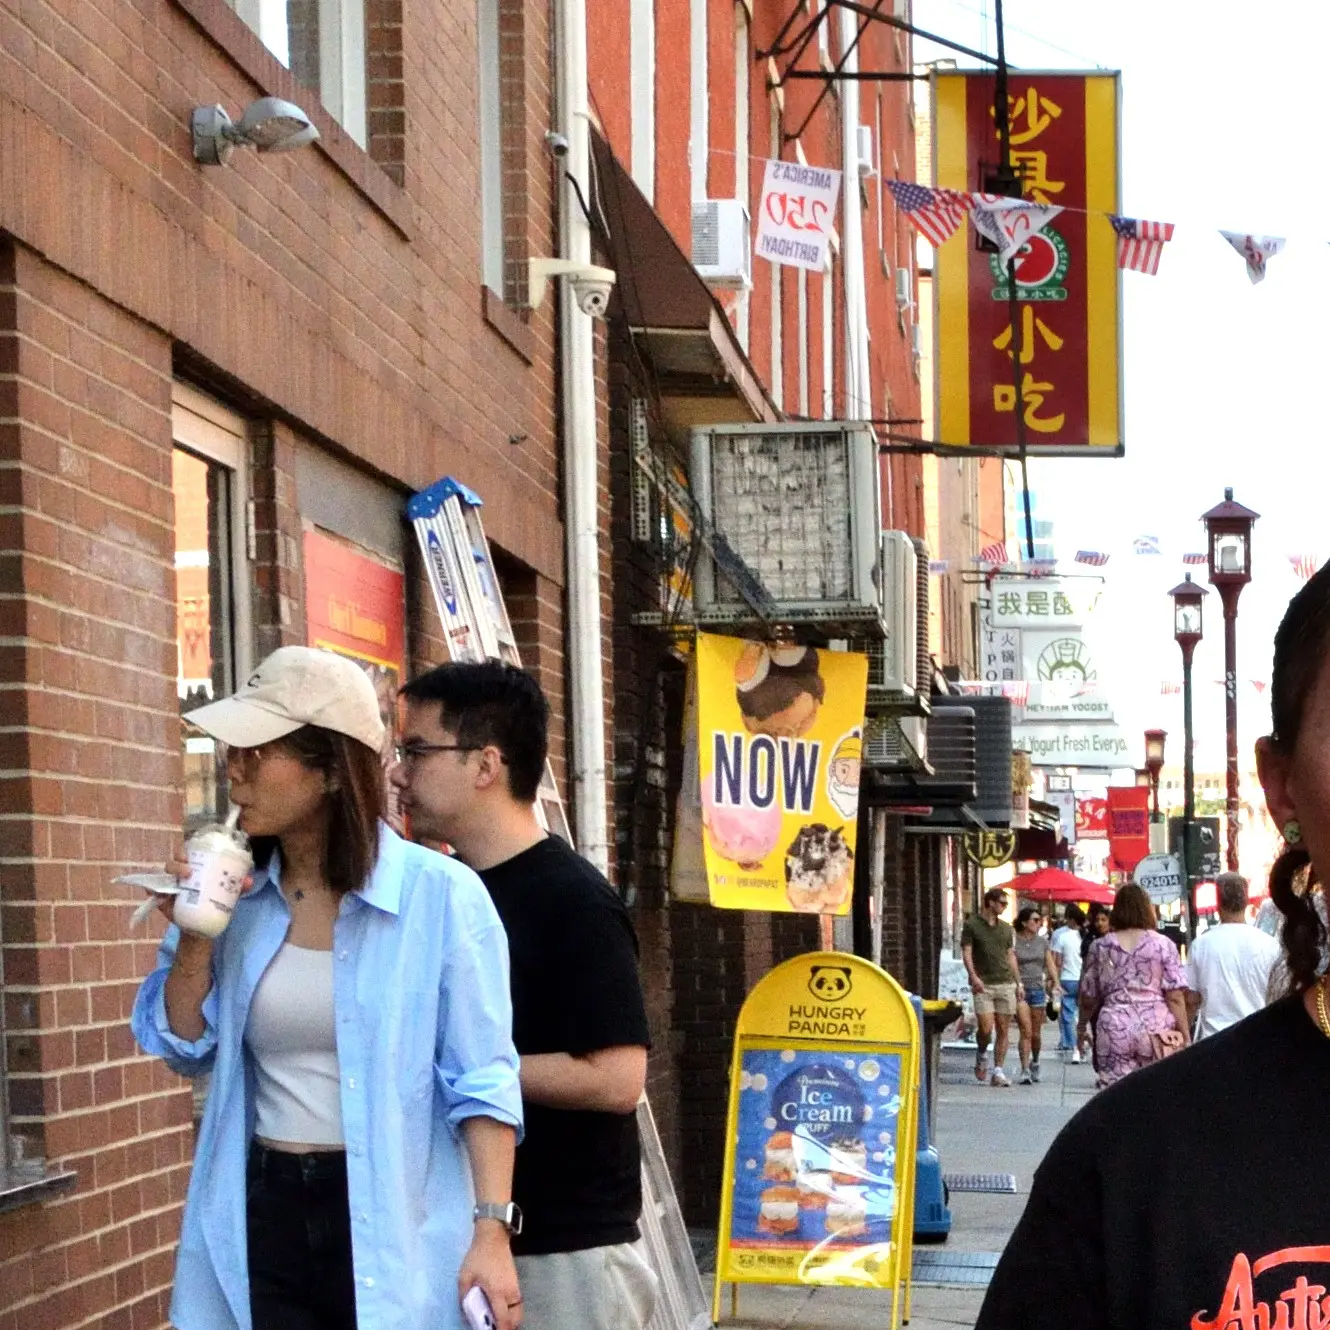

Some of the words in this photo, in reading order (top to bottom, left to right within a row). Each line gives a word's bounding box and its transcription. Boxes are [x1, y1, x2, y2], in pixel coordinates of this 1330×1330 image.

[1028, 736, 1060, 757] Yogurt
[1063, 735, 1089, 751] Fresh
[714, 733, 820, 812] NOW
[1140, 875, 1180, 888] 924014
[789, 1005, 866, 1021] HUNGRY
[788, 1020, 850, 1036] PANDA
[801, 1085, 833, 1105] Ice
[780, 1102, 854, 1123] Cream
